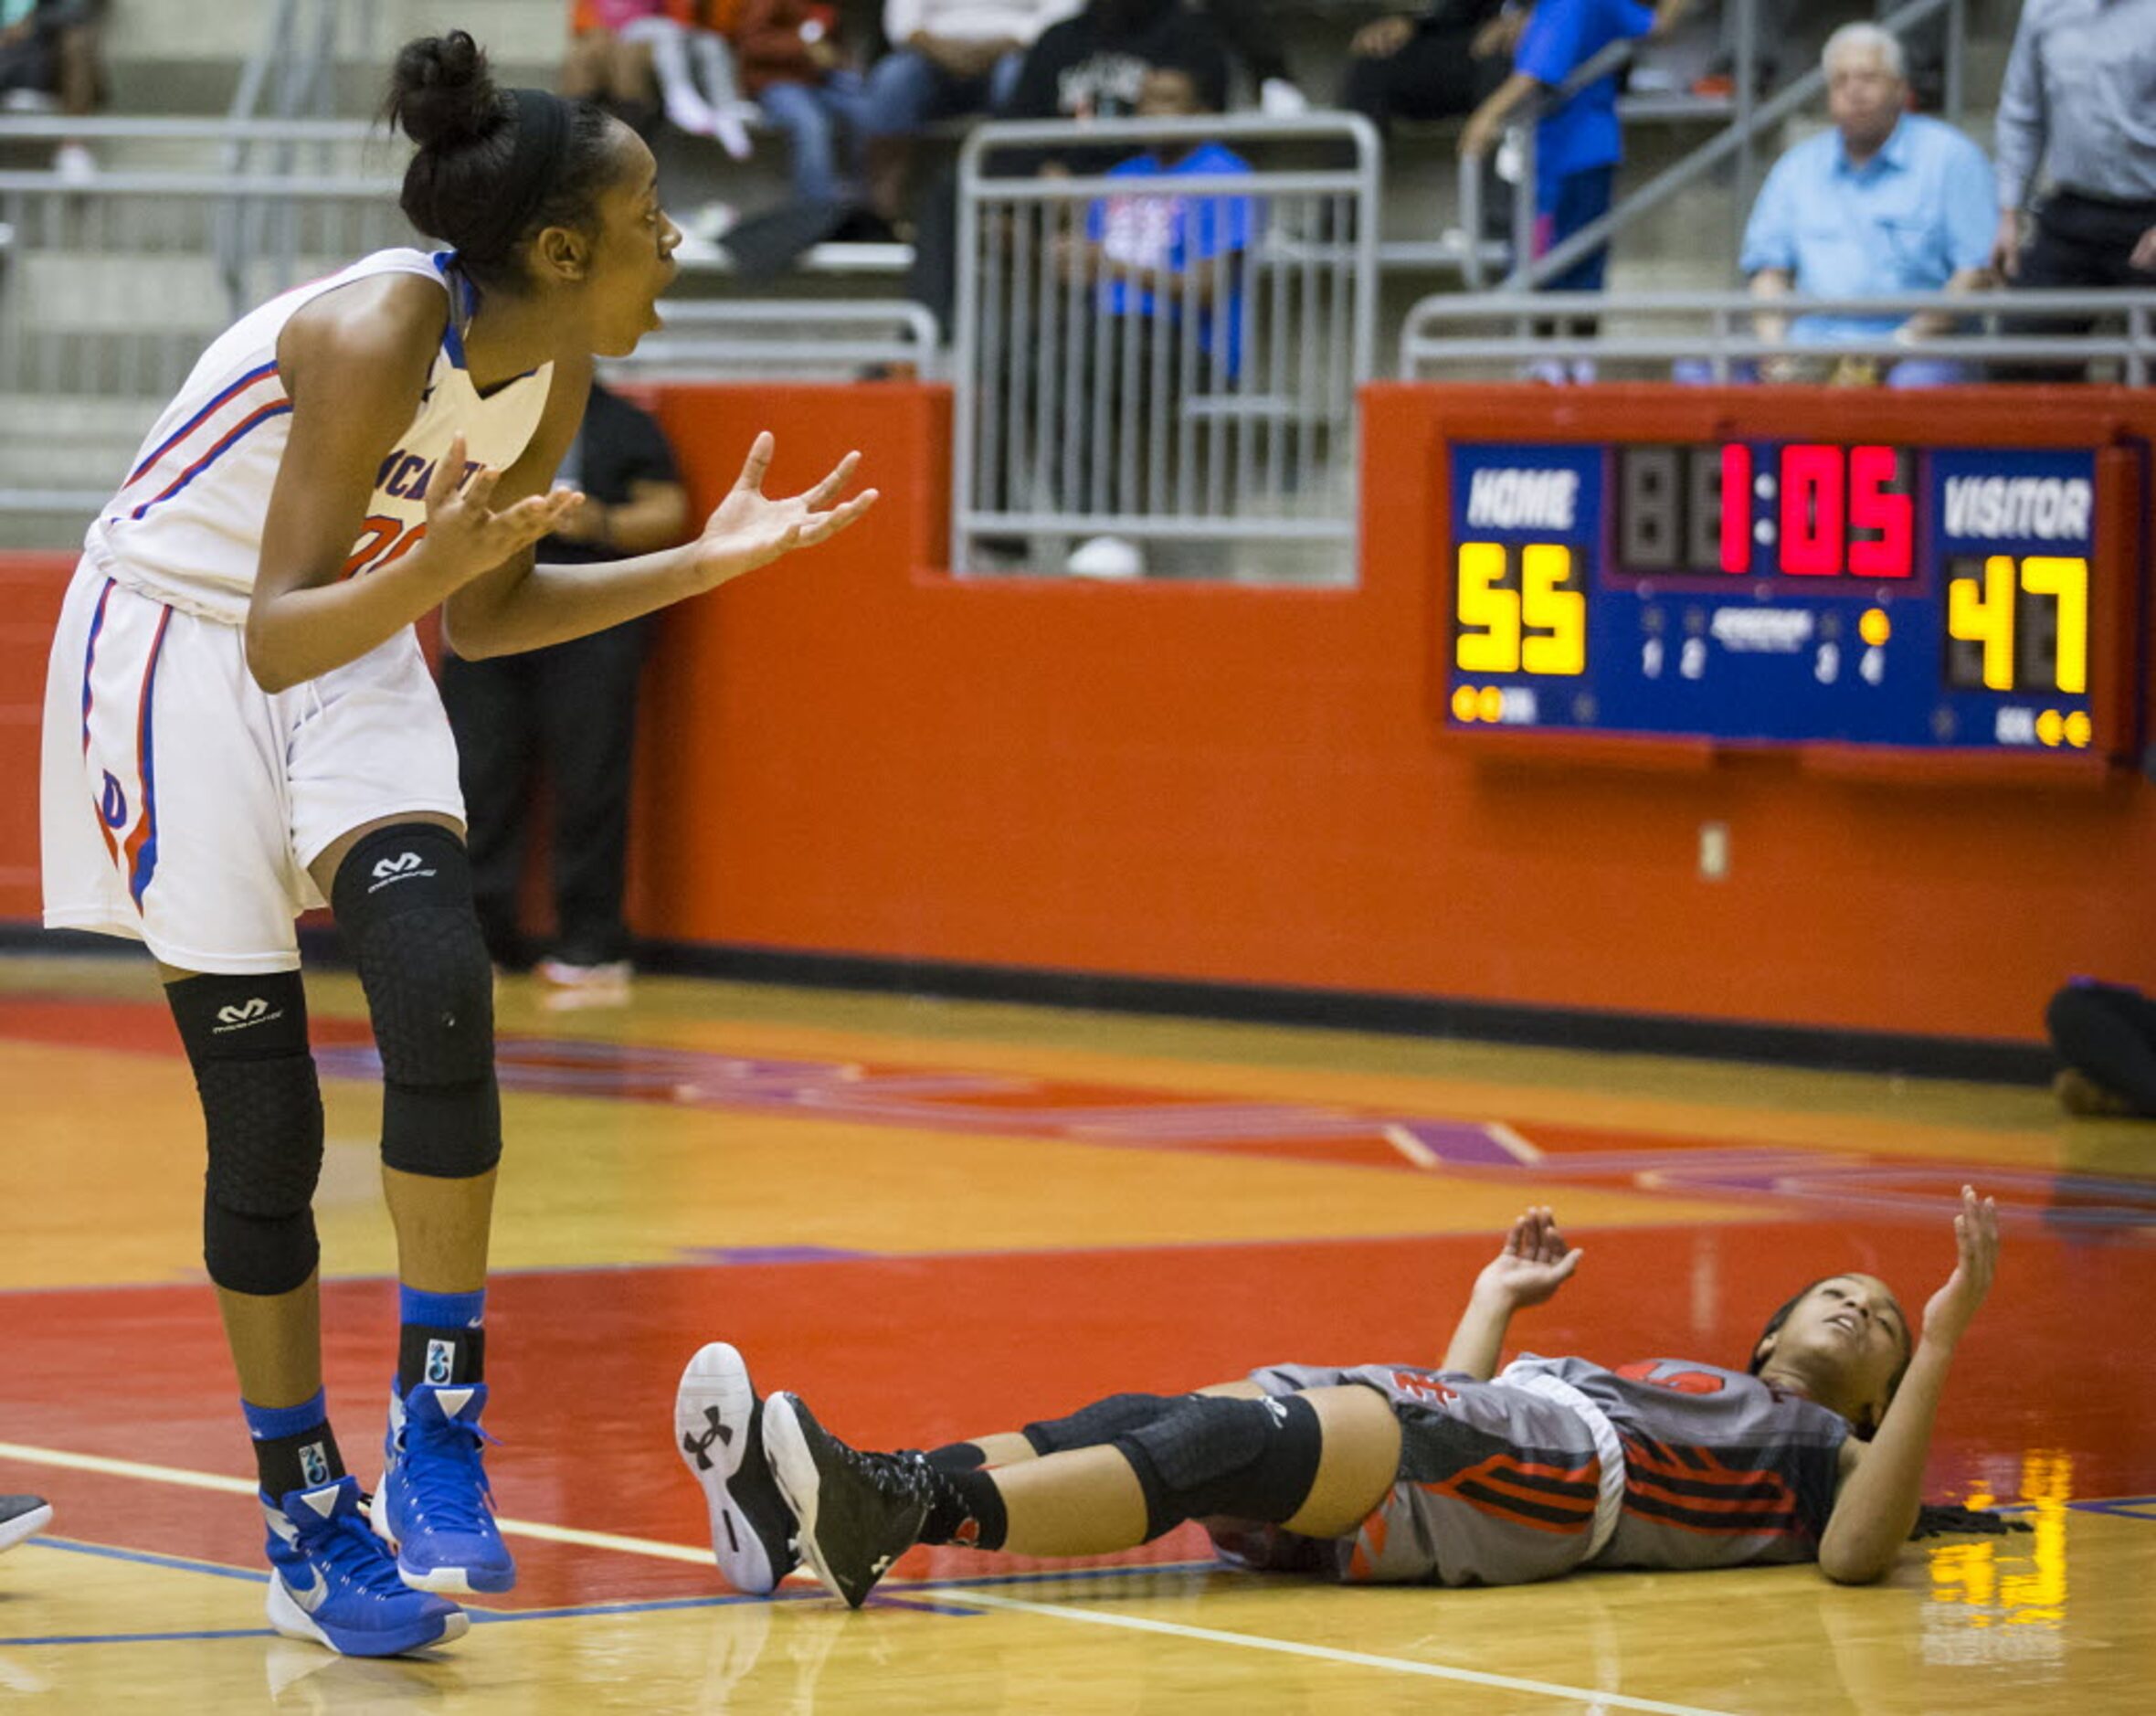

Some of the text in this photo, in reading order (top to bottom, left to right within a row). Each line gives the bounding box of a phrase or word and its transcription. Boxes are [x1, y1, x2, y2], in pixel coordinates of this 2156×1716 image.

[1467, 468, 1580, 530] HOME
[1720, 443, 1913, 577] 1:05
[1944, 476, 2093, 539] VISITOR
[1456, 542, 1586, 675] 55
[1949, 556, 2088, 694] 47
